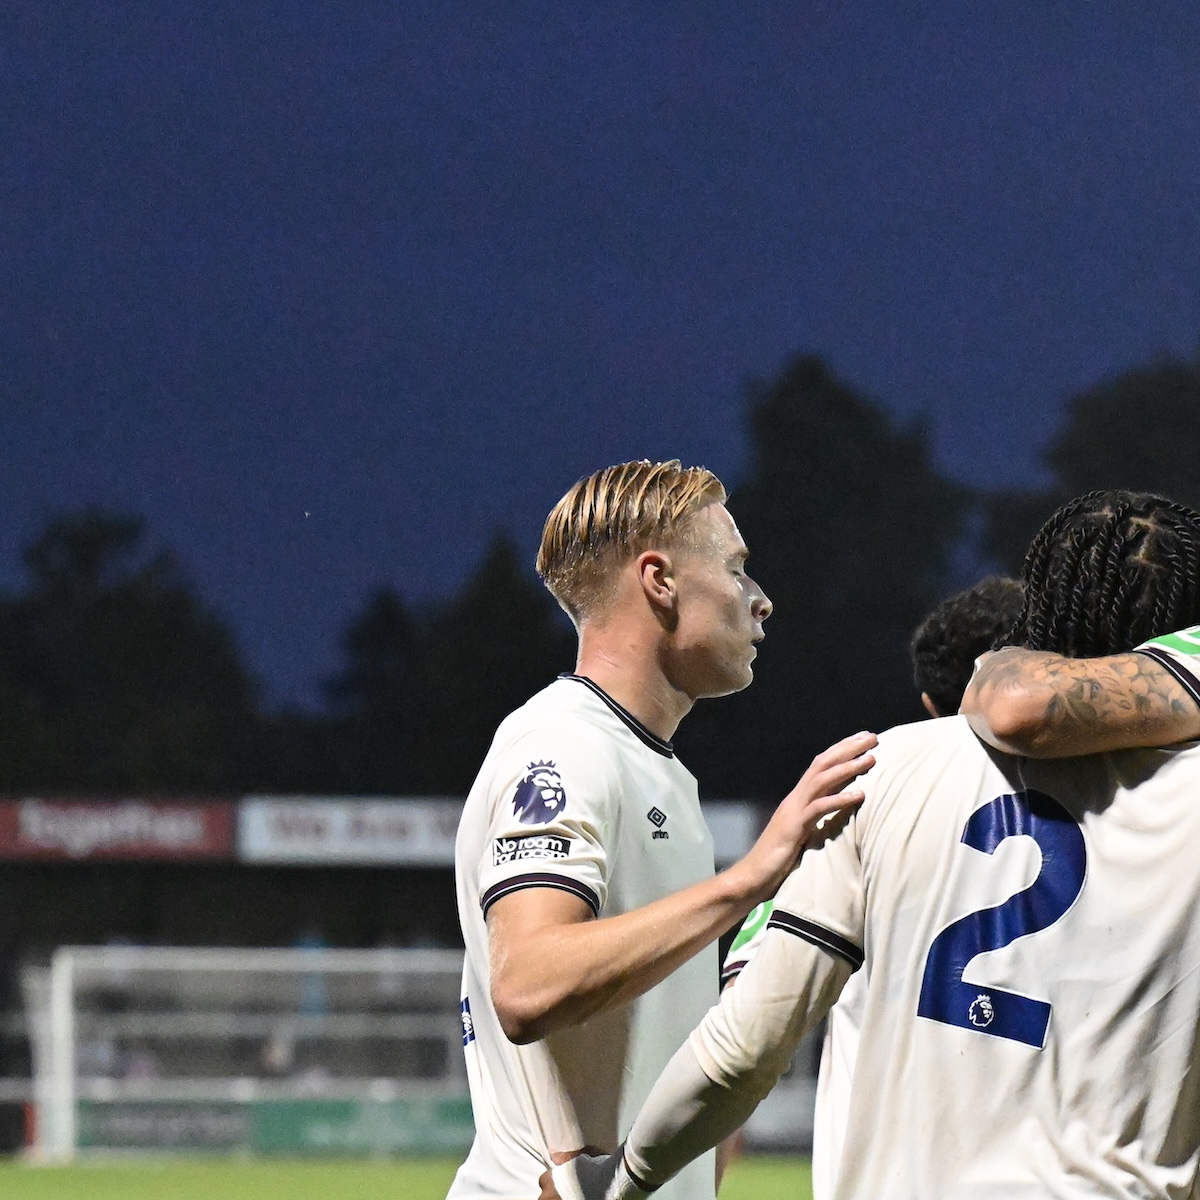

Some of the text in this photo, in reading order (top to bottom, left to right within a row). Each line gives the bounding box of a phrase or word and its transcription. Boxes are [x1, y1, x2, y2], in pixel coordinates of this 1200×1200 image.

[492, 837, 563, 854] No room
[915, 787, 1087, 1050] 2
